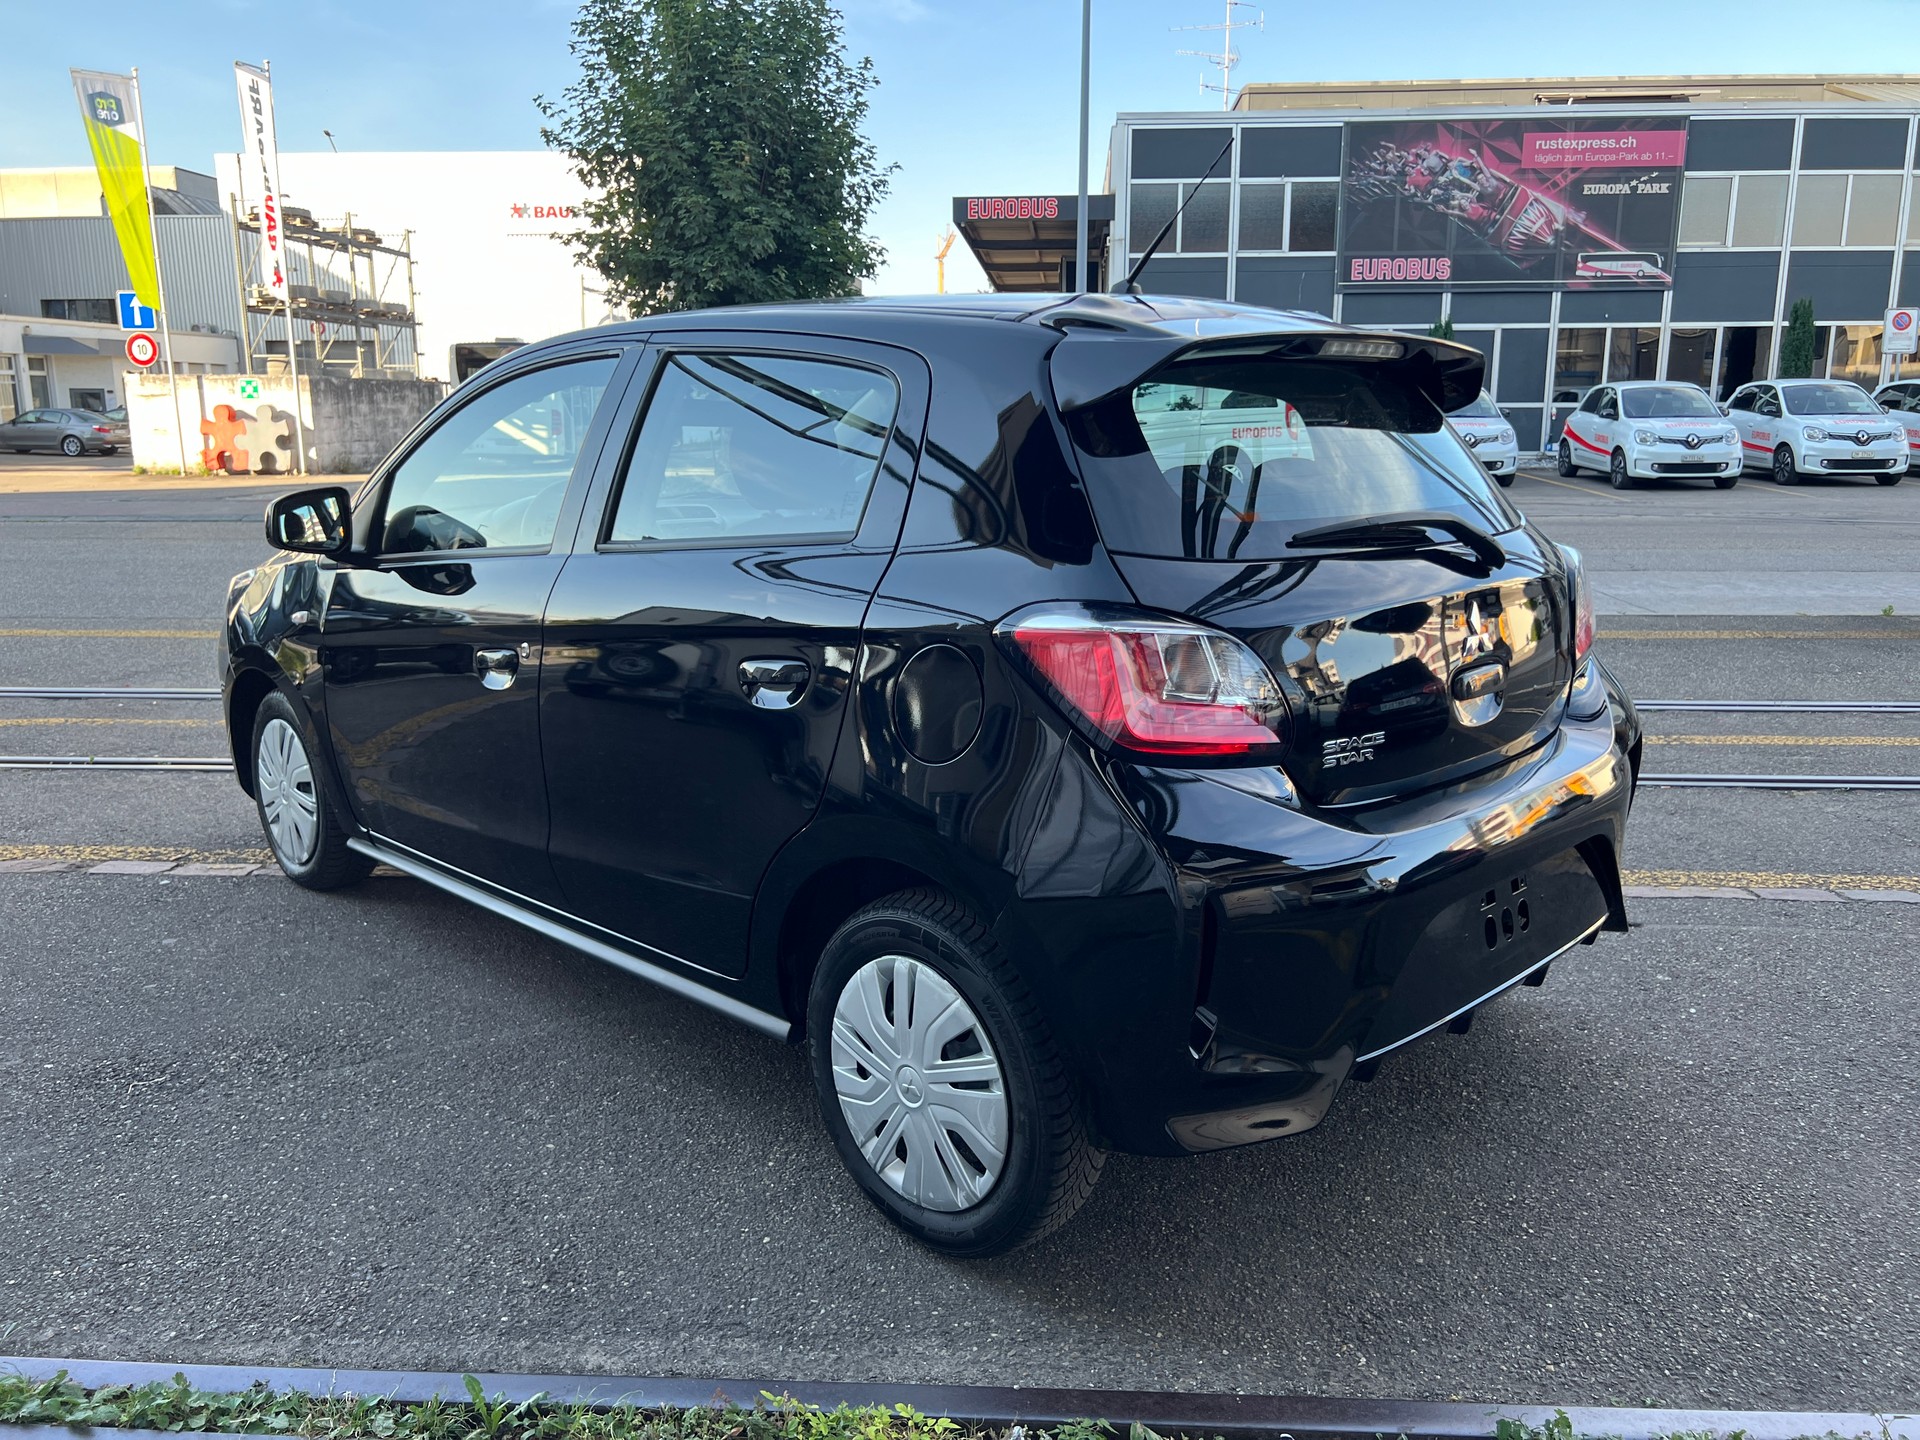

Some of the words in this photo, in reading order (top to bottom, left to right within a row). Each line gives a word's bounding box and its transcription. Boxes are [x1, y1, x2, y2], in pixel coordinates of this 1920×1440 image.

[1535, 136, 1637, 151] rustexpress.ch
[1534, 153, 1562, 163] täglich
[1585, 153, 1639, 163] Europa-Park
[1640, 153, 1653, 161] ab
[1582, 183, 1631, 195] EUROPA
[1636, 182, 1671, 194] PARK
[533, 206, 574, 218] BAU
[968, 198, 1058, 219] EUROBUS
[1351, 258, 1451, 280] EUROBUS
[137, 344, 147, 355] 10
[1232, 427, 1282, 439] EUROBUS
[1322, 731, 1386, 754] SPACE
[1322, 748, 1374, 769] STAR
